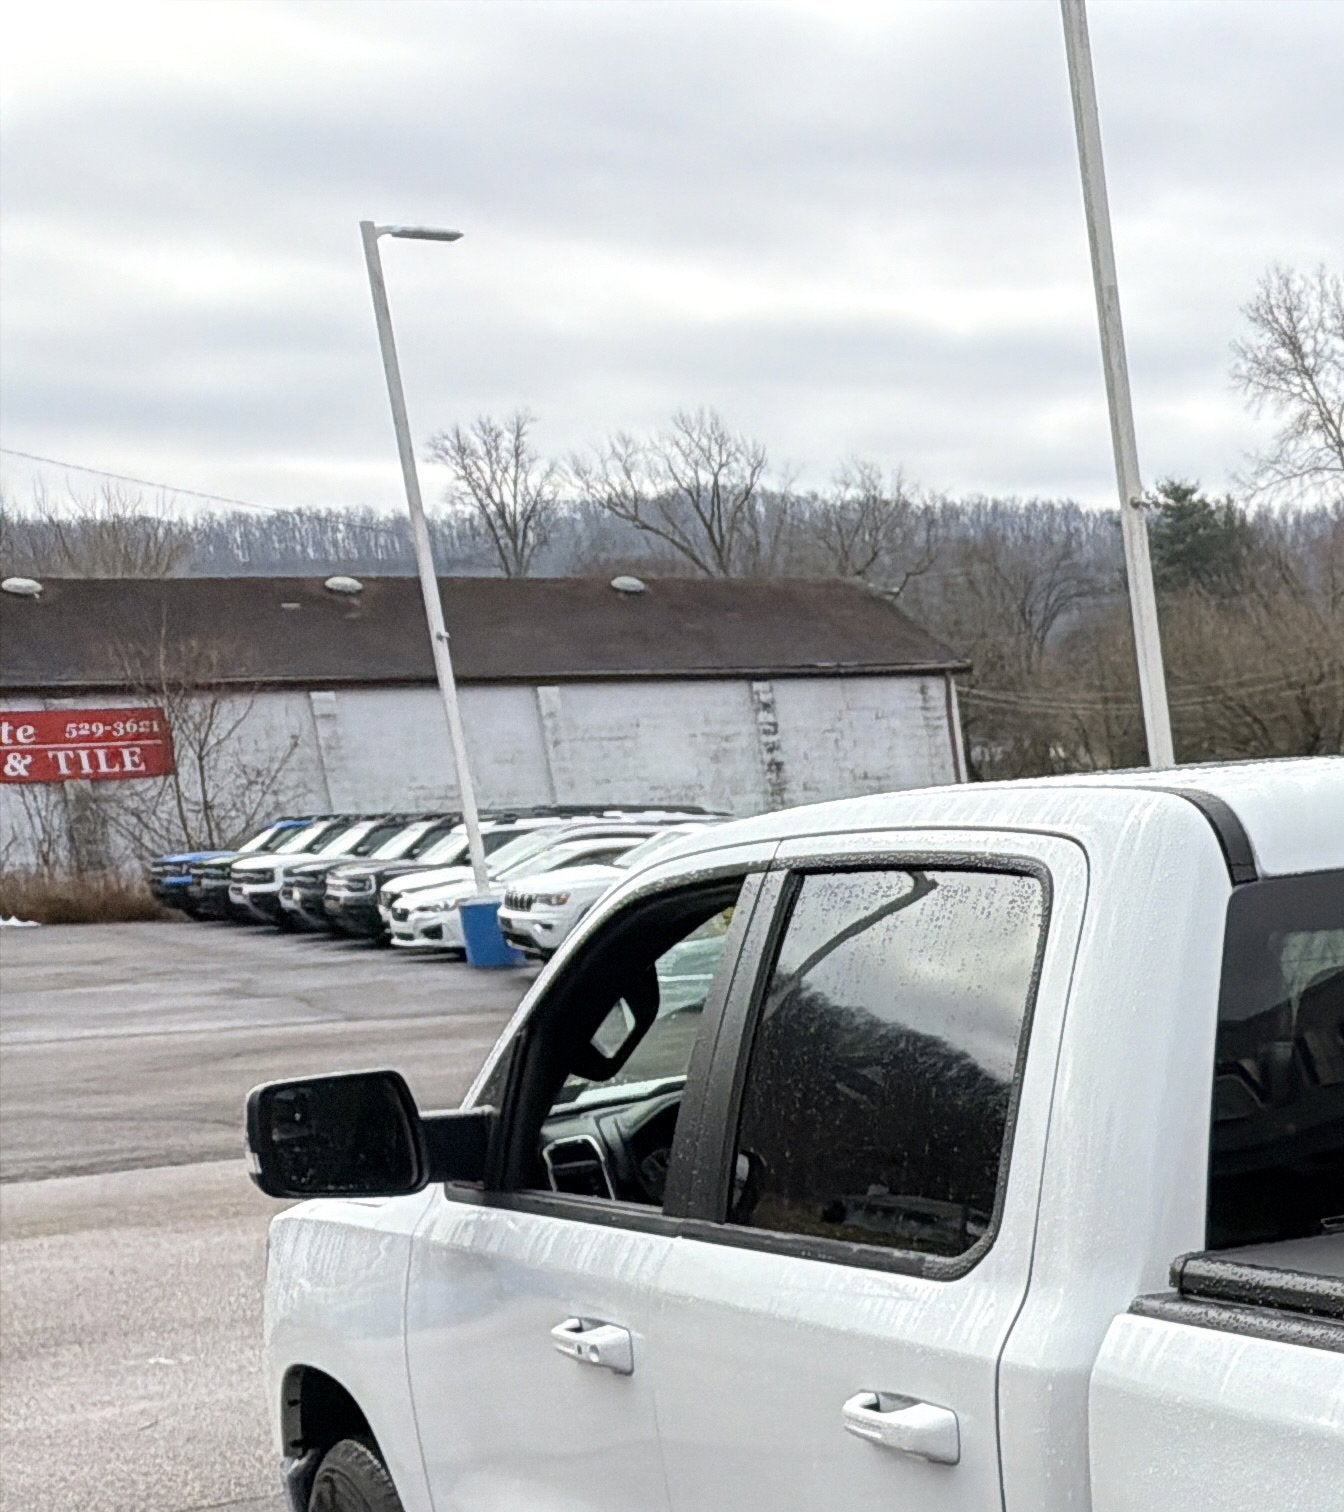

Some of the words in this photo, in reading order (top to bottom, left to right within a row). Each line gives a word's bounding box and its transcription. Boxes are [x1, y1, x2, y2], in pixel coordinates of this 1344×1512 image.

[65, 718, 159, 739] 529-3621
[3, 752, 32, 777] &
[47, 747, 146, 775] TILE
